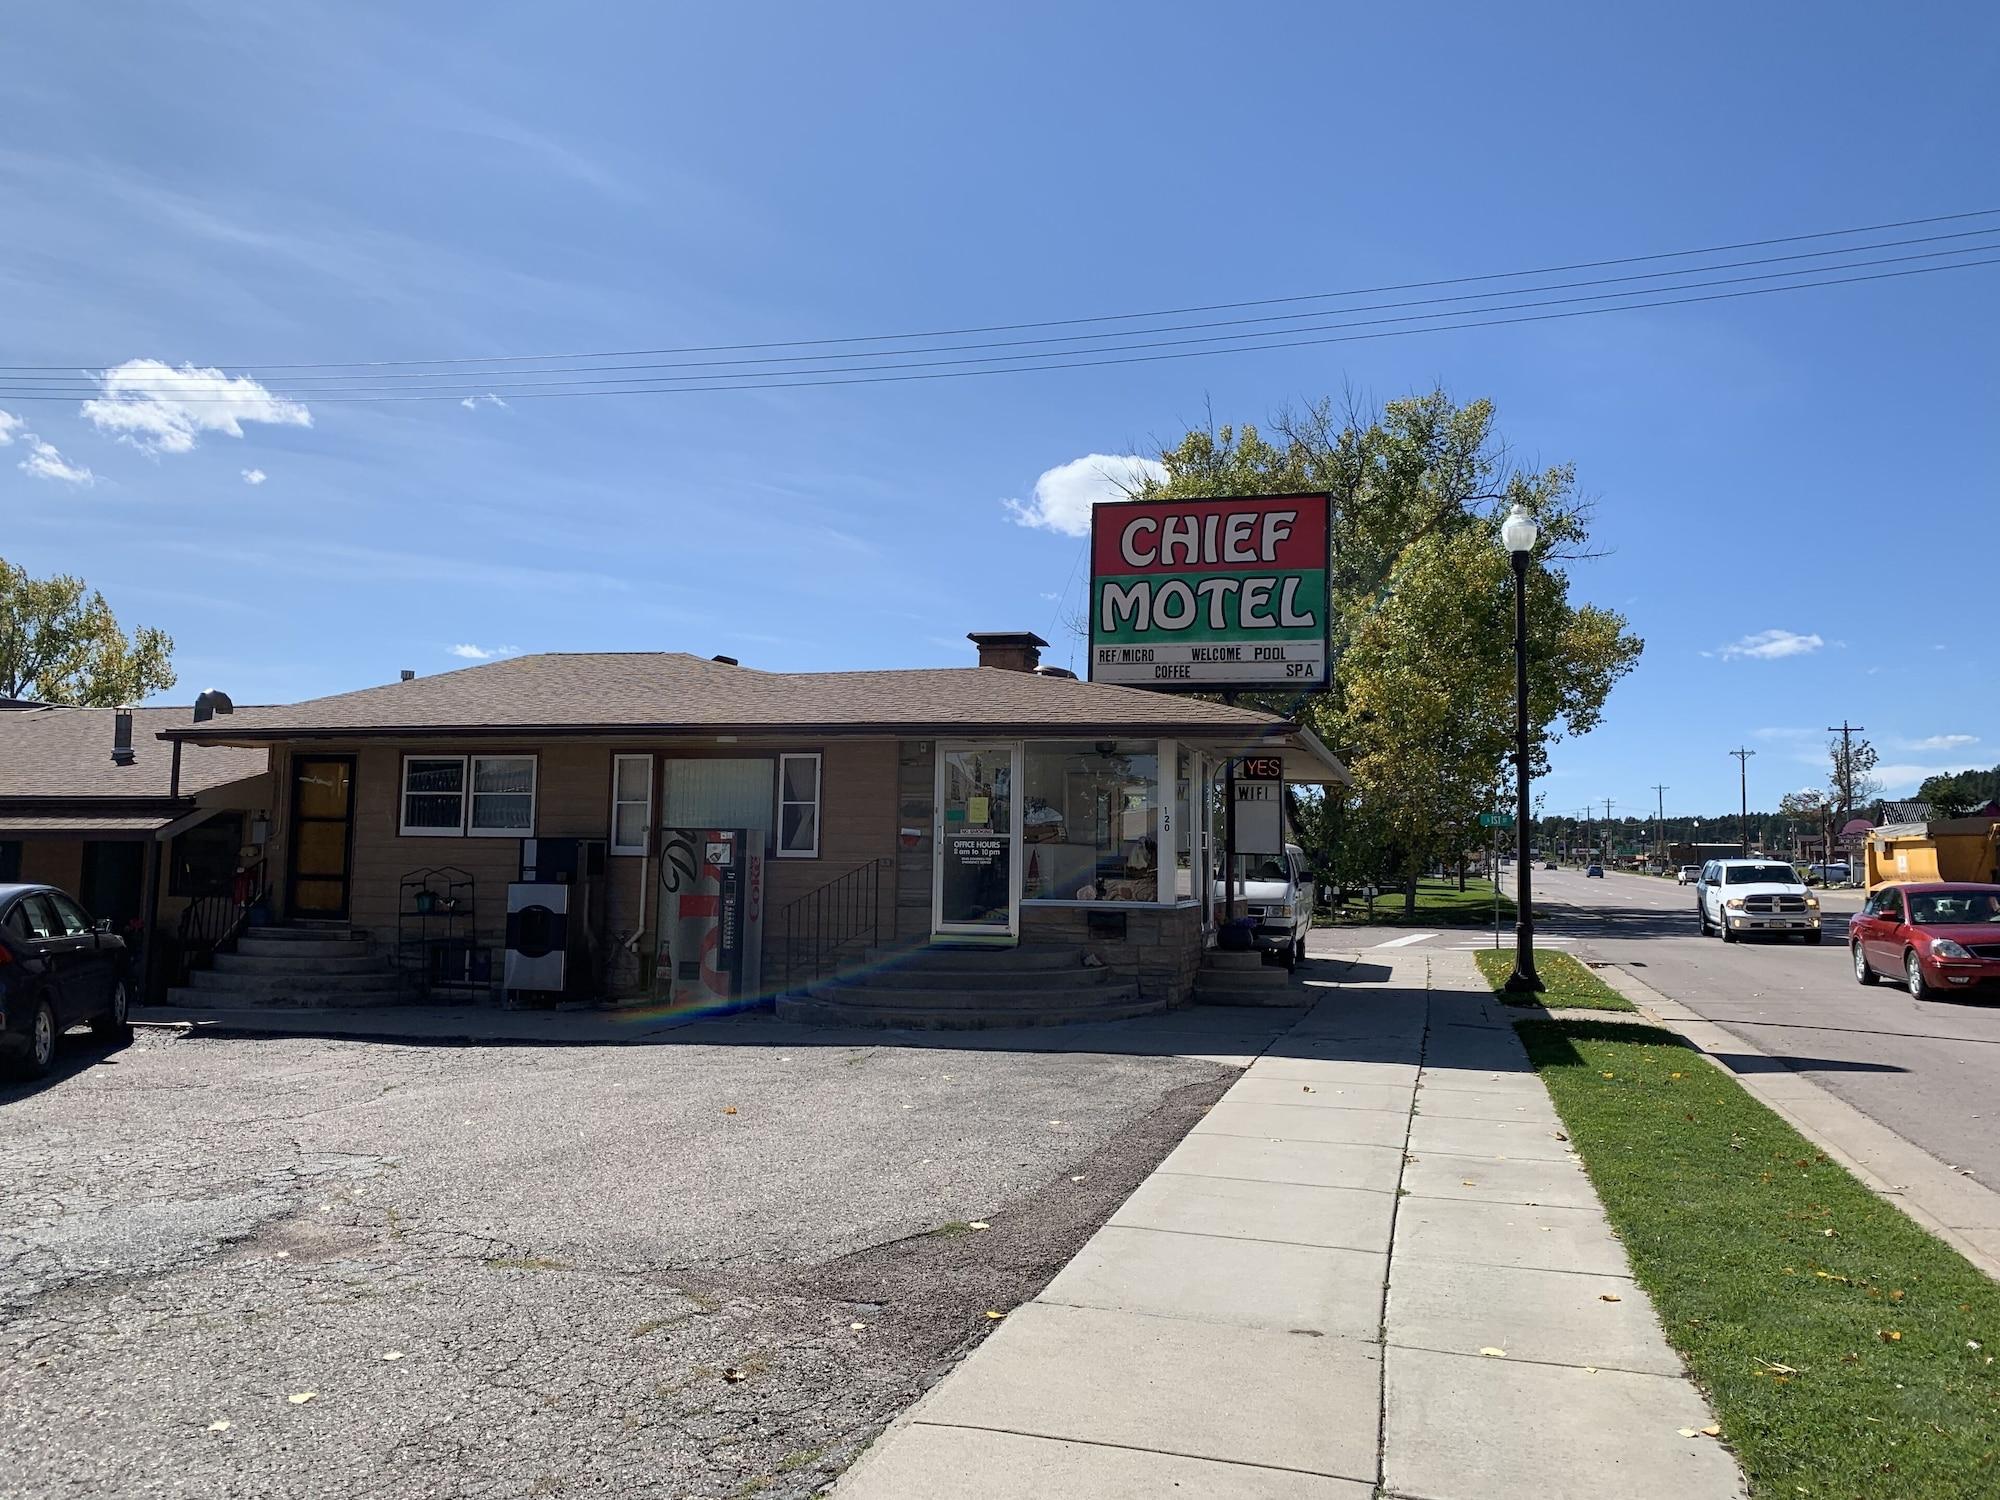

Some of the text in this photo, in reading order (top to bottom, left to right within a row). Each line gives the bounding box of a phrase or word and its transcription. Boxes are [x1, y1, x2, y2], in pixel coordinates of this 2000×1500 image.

[1121, 511, 1299, 567] CHIEF
[1102, 576, 1316, 633] MOTEL
[1099, 647, 1286, 662] REF/MICRO WELCOME POOL
[1155, 663, 1314, 678] COFFEE SPA
[1247, 759, 1280, 776] YES
[1239, 786, 1268, 800] WIFI
